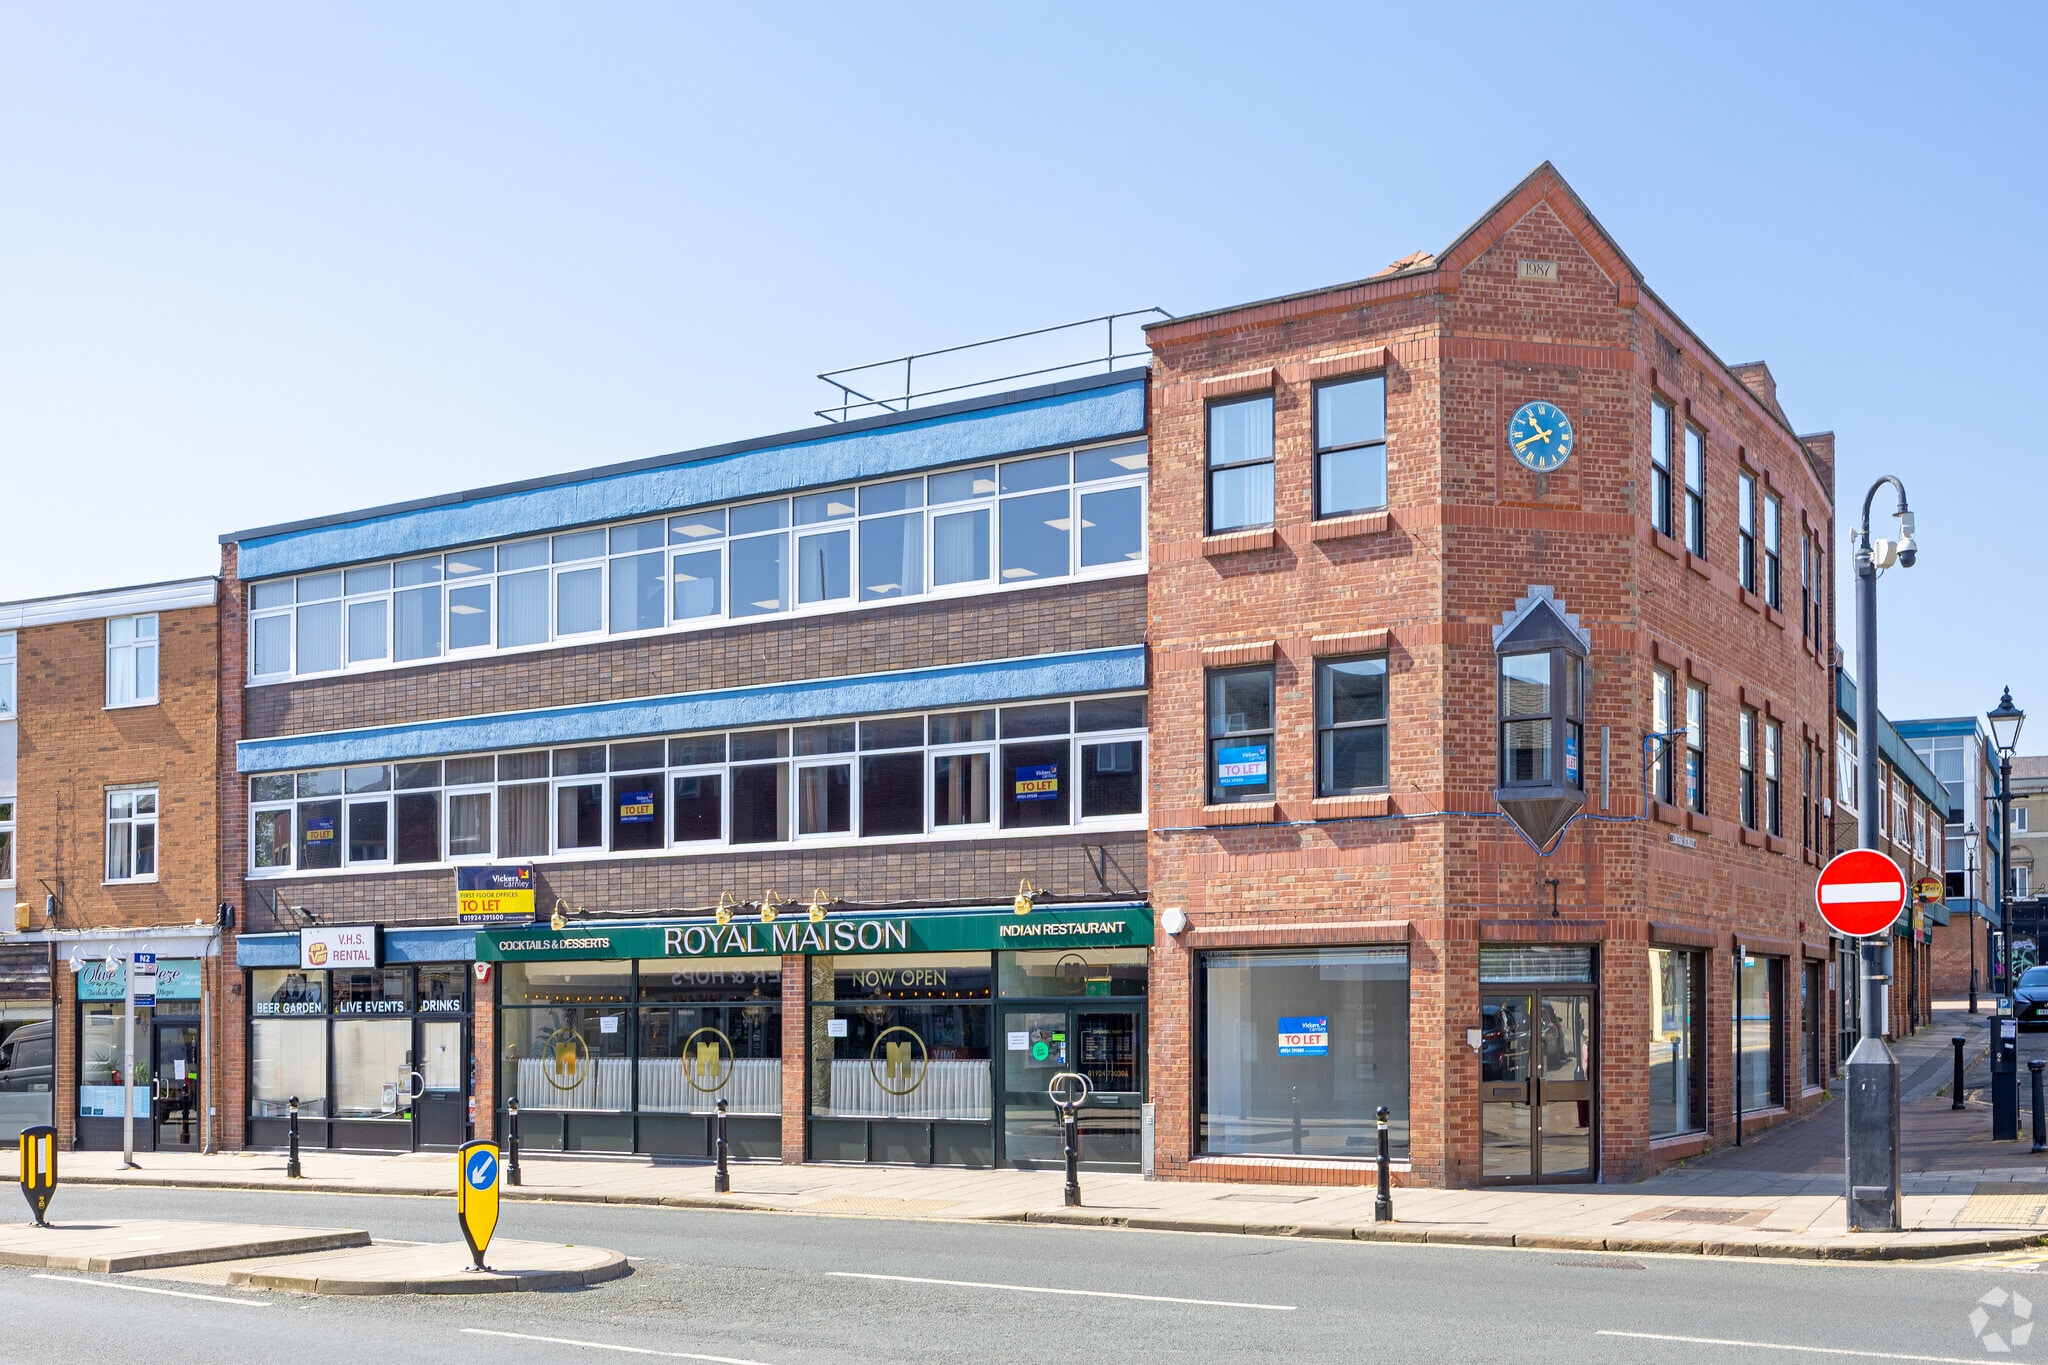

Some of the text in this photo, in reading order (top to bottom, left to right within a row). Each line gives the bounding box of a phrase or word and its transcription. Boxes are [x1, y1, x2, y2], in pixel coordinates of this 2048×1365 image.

[1525, 262, 1551, 277] 1987
[1225, 763, 1261, 776] TO LET
[1021, 780, 1052, 792] TO LET
[625, 805, 649, 815] TO LET
[310, 830, 331, 839] TO LET
[492, 874, 519, 883] Vickers
[503, 880, 530, 889] carnley
[461, 900, 501, 912] TO LET
[1000, 921, 1126, 937] INDIAN RESTAURANT
[338, 934, 365, 945] V.H.S.
[664, 920, 906, 954] ROYAL MAISON
[499, 937, 610, 951] COCKTAILS & DESSERTS
[139, 954, 151, 963] N2
[333, 950, 371, 961] RENTAL
[83, 963, 181, 984] Olive eze
[852, 969, 947, 987] NOW OPEN
[257, 1002, 322, 1014] BEER GARDEN
[340, 1000, 404, 1013] LIVE EVENTS
[422, 999, 460, 1012] DRINKS
[1285, 1034, 1321, 1045] TO LET
